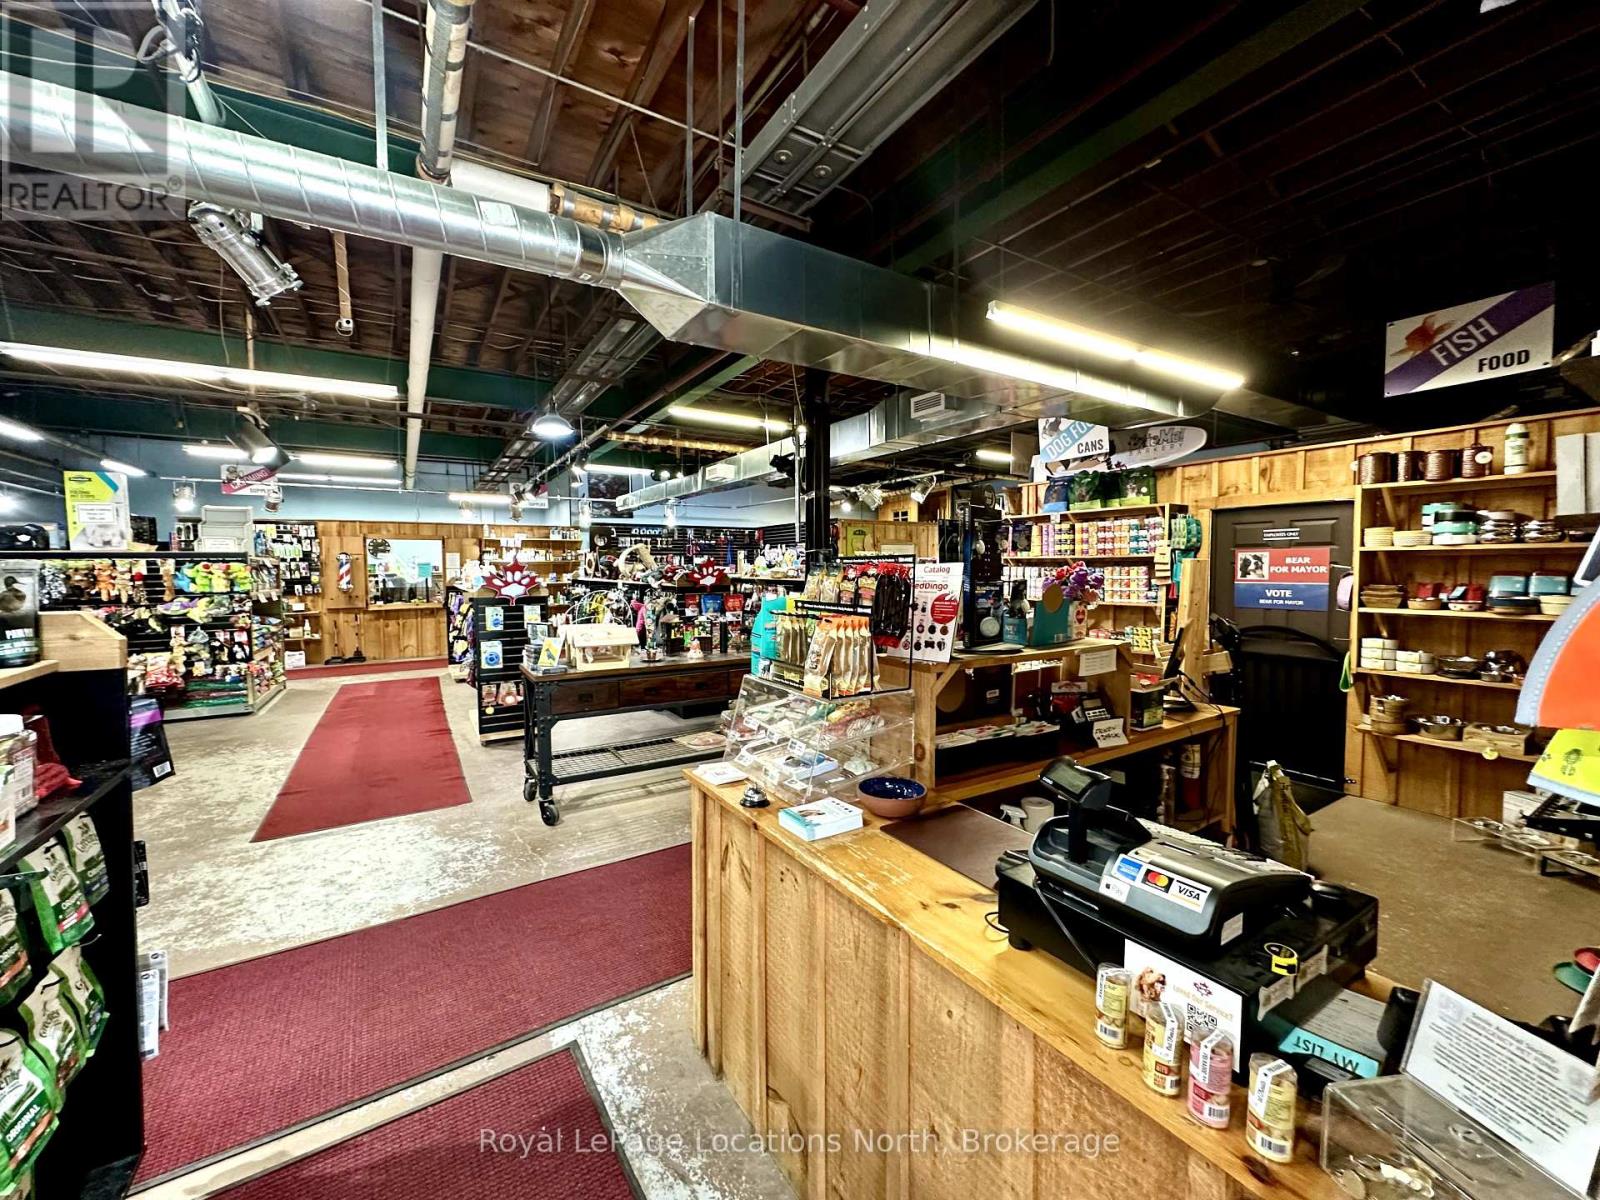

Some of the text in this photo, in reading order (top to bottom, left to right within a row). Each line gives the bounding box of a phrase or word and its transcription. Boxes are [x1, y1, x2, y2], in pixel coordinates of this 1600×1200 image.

[1430, 316, 1498, 366] FISH
[1478, 349, 1530, 372] FOOD
[1045, 433, 1073, 459] DOG
[1077, 439, 1104, 454] CANS
[1285, 556, 1311, 564] BEAR
[923, 566, 951, 574] Catalog
[1270, 565, 1328, 573] FOR MAYOR
[1265, 589, 1292, 597] VOTE
[1177, 885, 1201, 901] VISA
[1293, 1036, 1359, 1072] MY LIST
[6, 1104, 41, 1142] ORIGINAL
